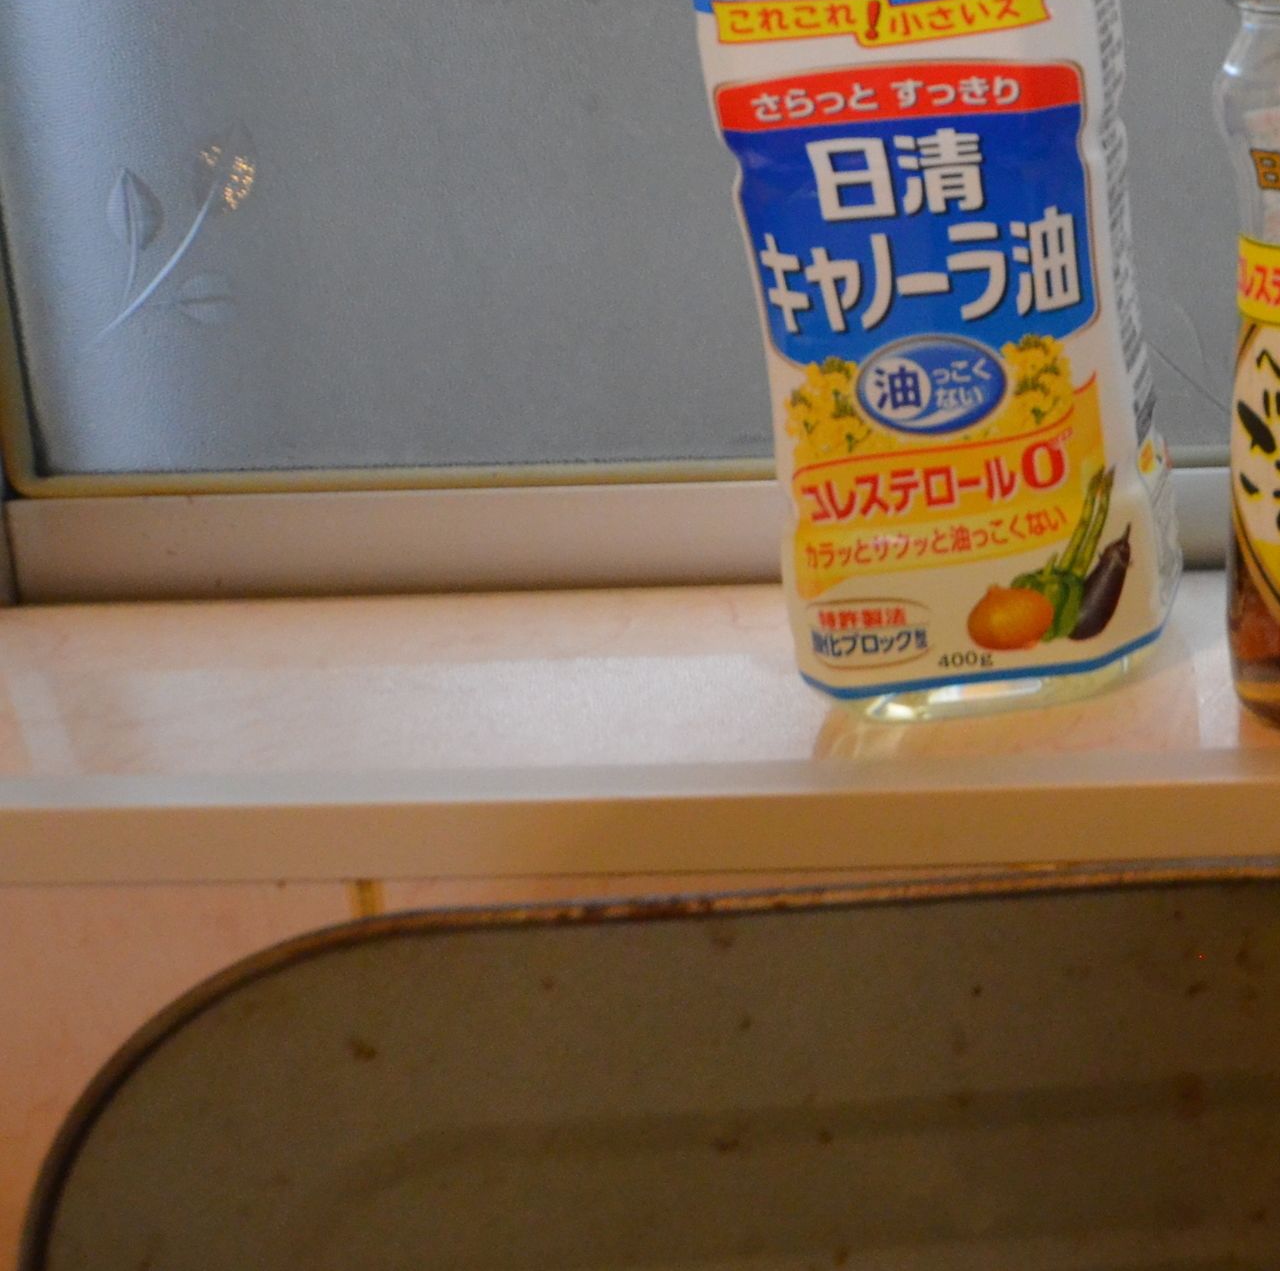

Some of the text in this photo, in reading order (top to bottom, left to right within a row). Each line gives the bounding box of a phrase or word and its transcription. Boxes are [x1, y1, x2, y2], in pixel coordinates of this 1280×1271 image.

[750, 76, 1021, 122] さらっと すっきり
[806, 128, 985, 222] 日清
[760, 205, 1083, 333] キャノーラ油
[873, 365, 923, 411] 油
[938, 651, 994, 668] 400g
